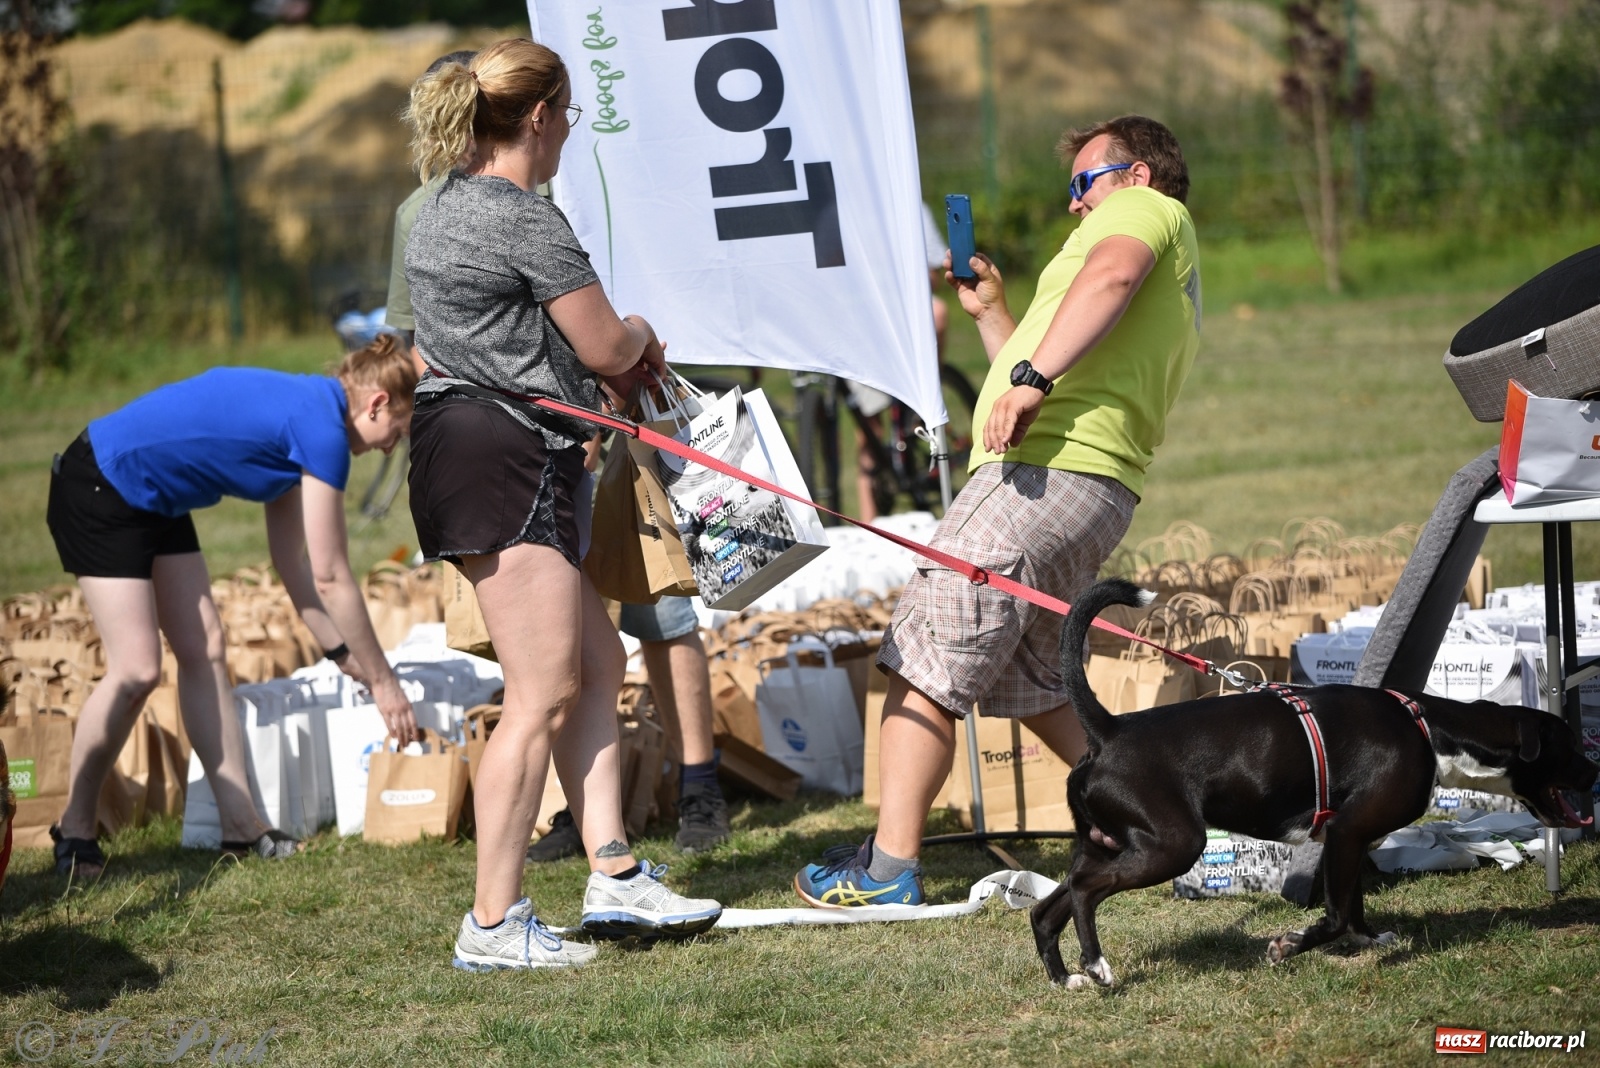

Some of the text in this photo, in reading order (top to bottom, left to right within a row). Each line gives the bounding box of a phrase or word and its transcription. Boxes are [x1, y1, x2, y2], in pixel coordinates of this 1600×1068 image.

[680, 415, 725, 459] ONTLINE
[705, 493, 749, 529] FRONTLINE
[711, 515, 757, 552] FRONTLINE
[715, 546, 730, 559] SPOT
[720, 536, 766, 574] FRONTLINE
[724, 564, 741, 581] SPRAY
[1316, 660, 1357, 671] FRONTL
[1203, 841, 1264, 853] FRONTLINE
[1205, 865, 1266, 878] FRONTLINE
[1207, 879, 1229, 887] SPRAY
